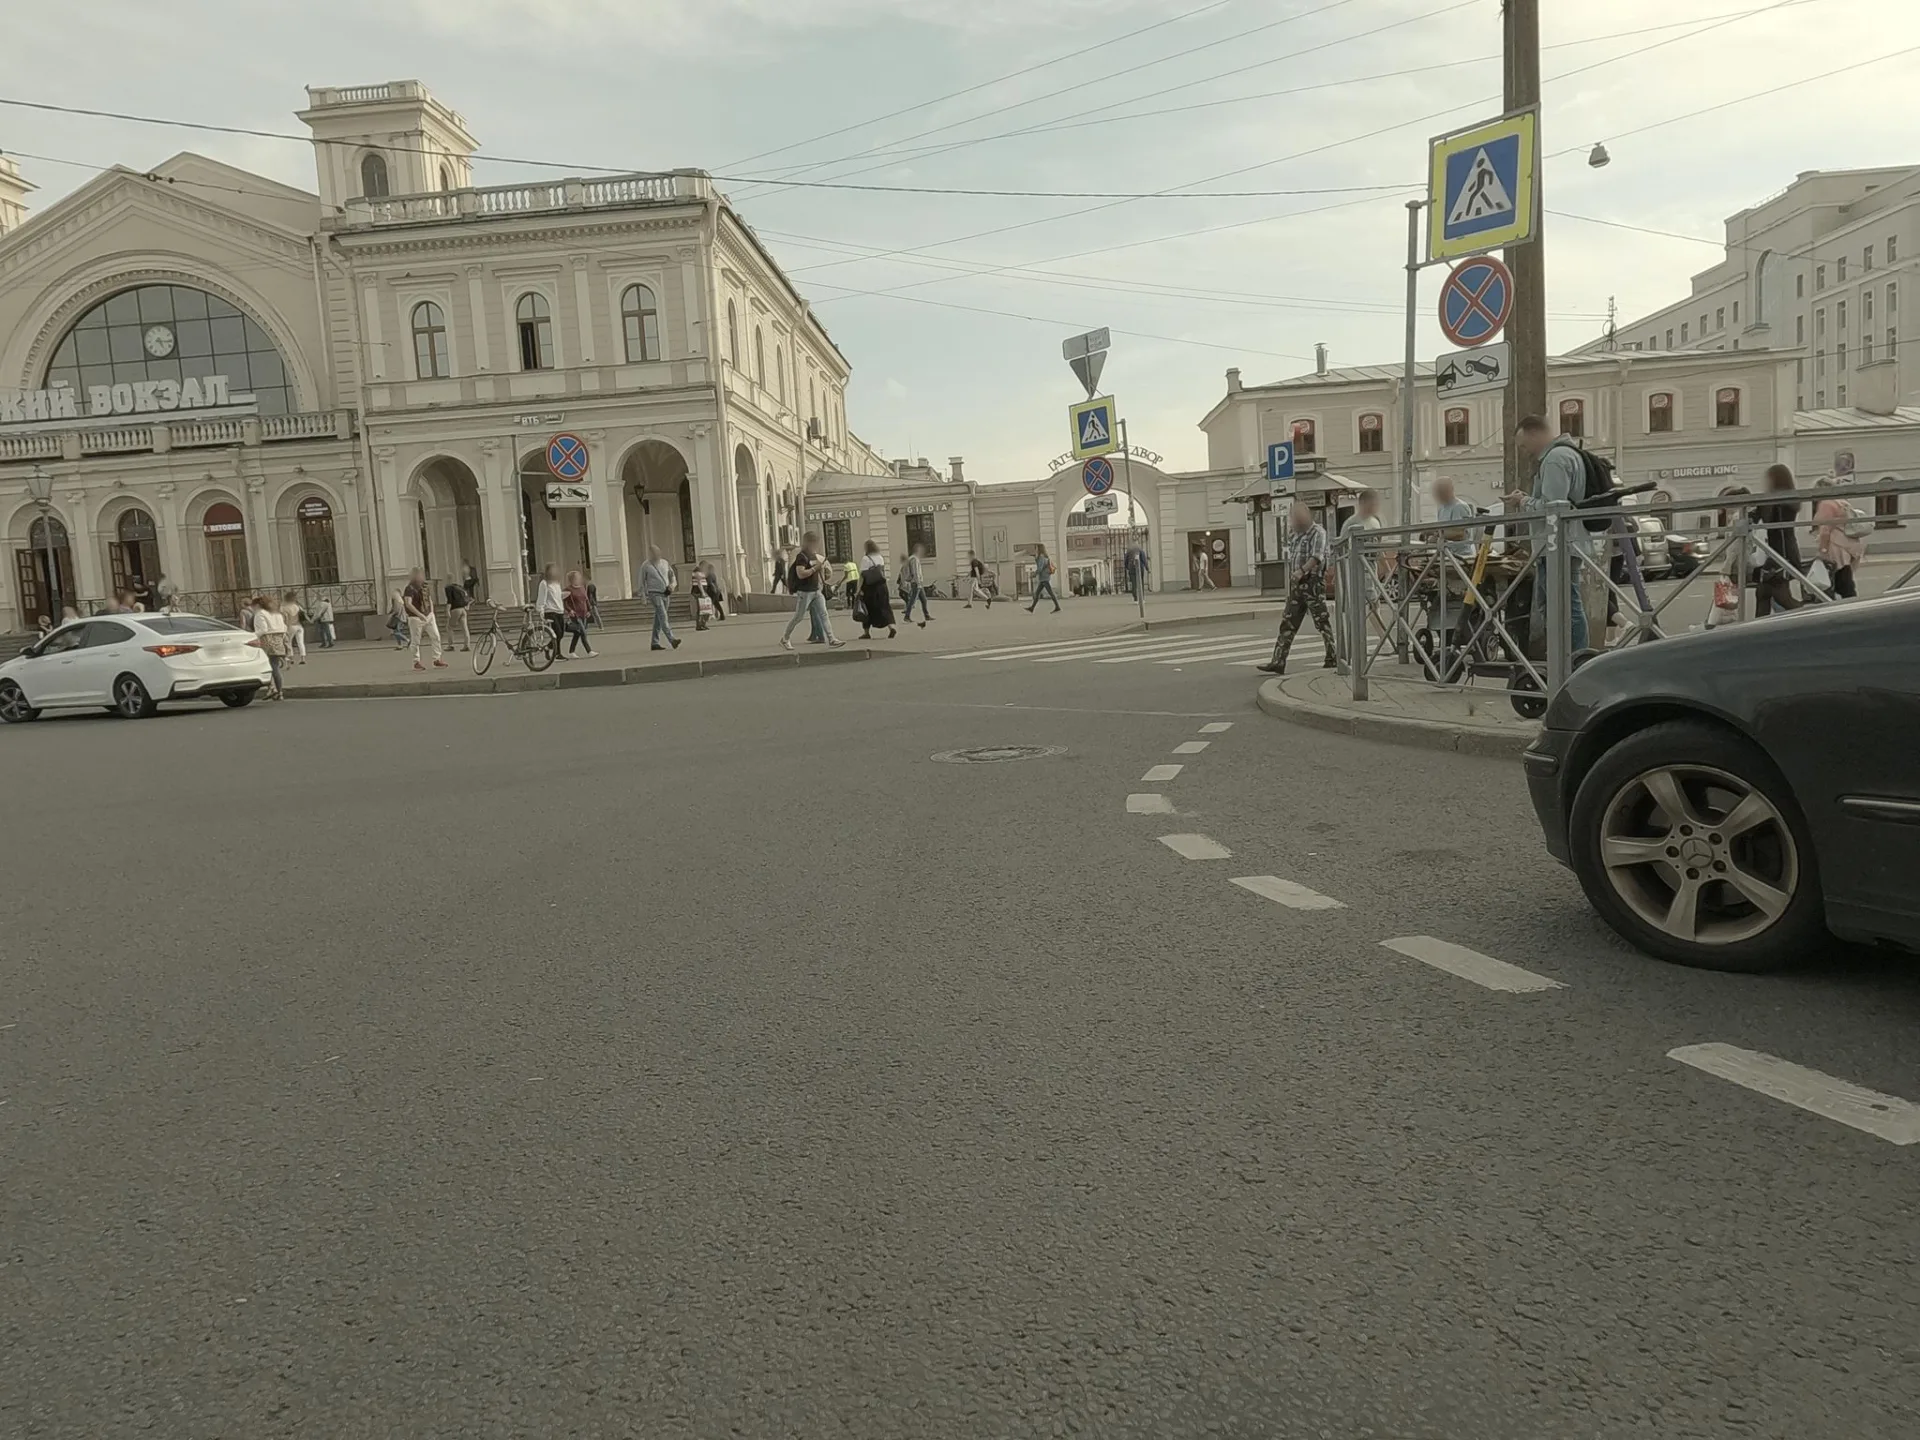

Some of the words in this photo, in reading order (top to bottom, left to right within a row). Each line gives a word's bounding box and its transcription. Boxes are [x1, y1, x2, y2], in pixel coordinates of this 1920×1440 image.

[88, 375, 230, 415] ВОКЗАЛ
[521, 415, 540, 425] ВТБ
[1130, 446, 1164, 466] ДВОР
[1274, 446, 1289, 476] P
[1673, 466, 1712, 478] BURGER
[1713, 465, 1739, 475] KING
[809, 512, 833, 520] BEER
[838, 509, 862, 519] CLUB
[906, 503, 948, 513] GILDIA
